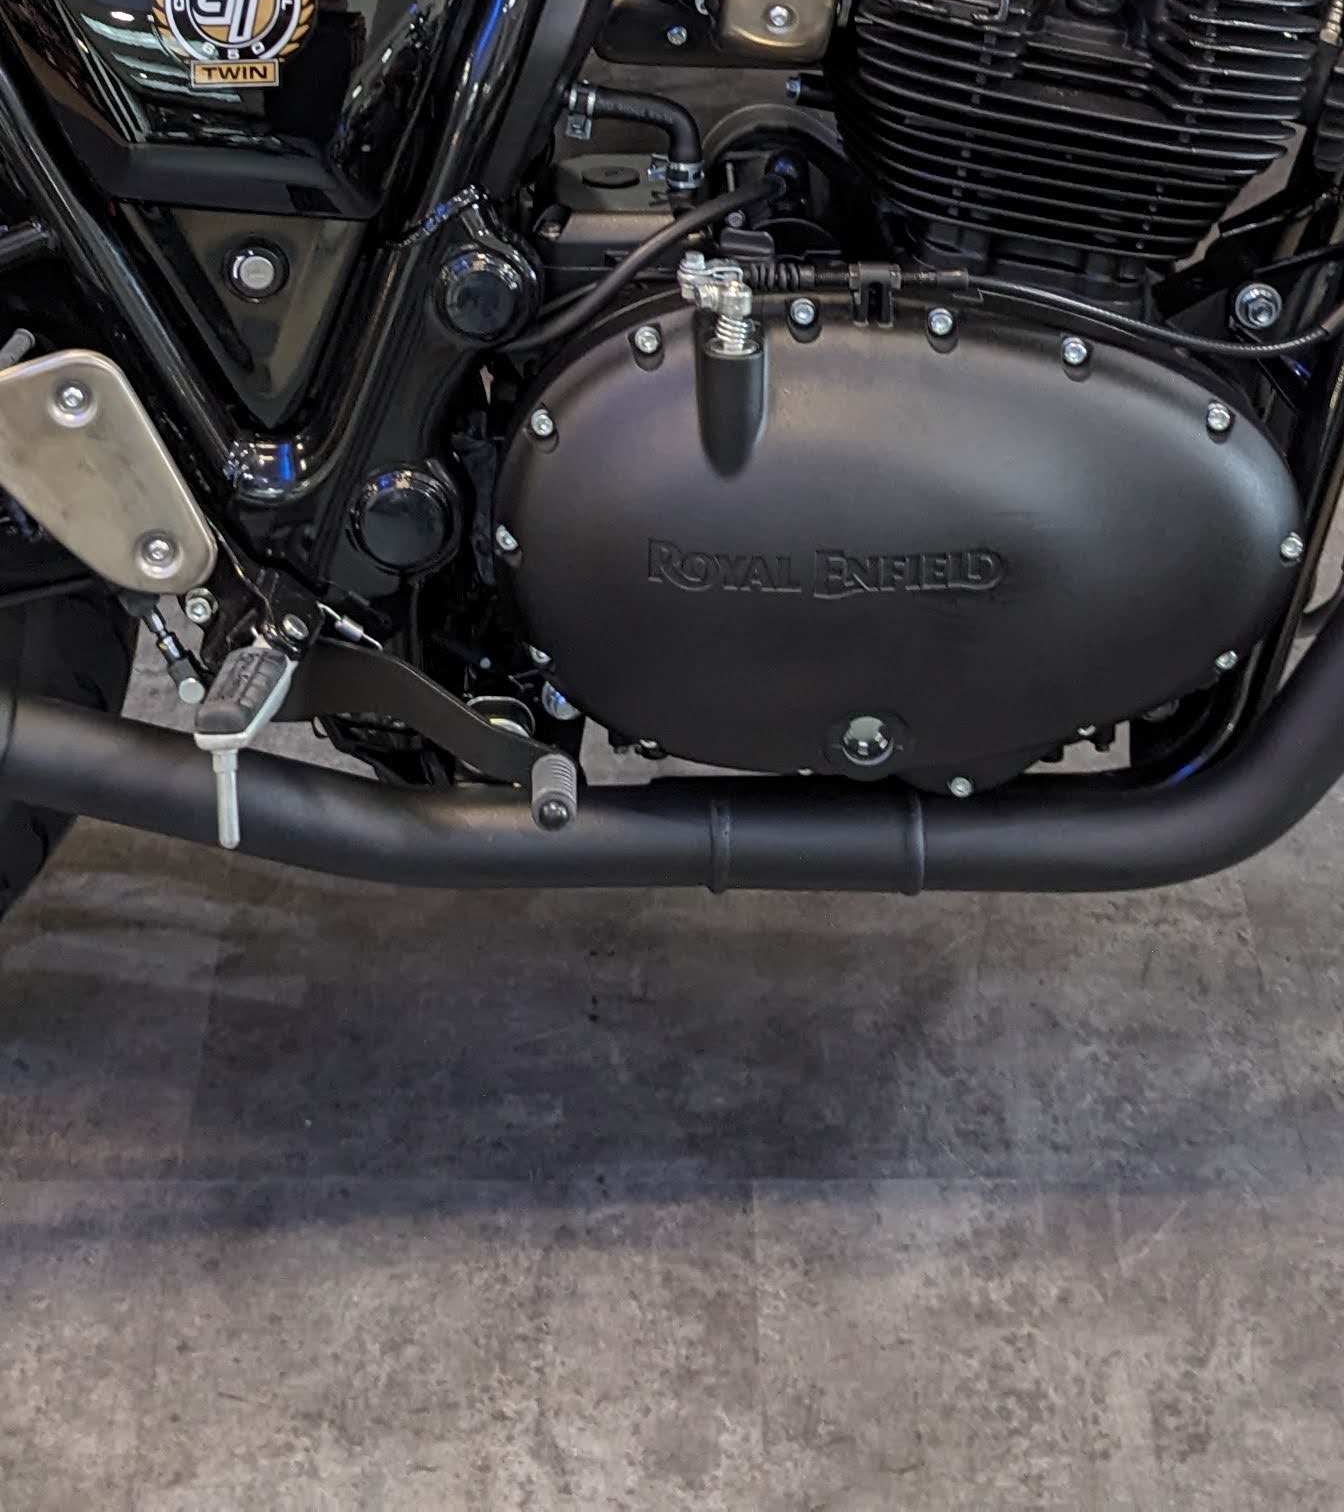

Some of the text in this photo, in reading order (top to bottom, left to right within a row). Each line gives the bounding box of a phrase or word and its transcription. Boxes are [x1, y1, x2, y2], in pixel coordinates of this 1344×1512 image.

[202, 42, 266, 60] 650
[201, 65, 267, 80] TWIN
[647, 539, 1003, 599] ROYAL ENFIELD
